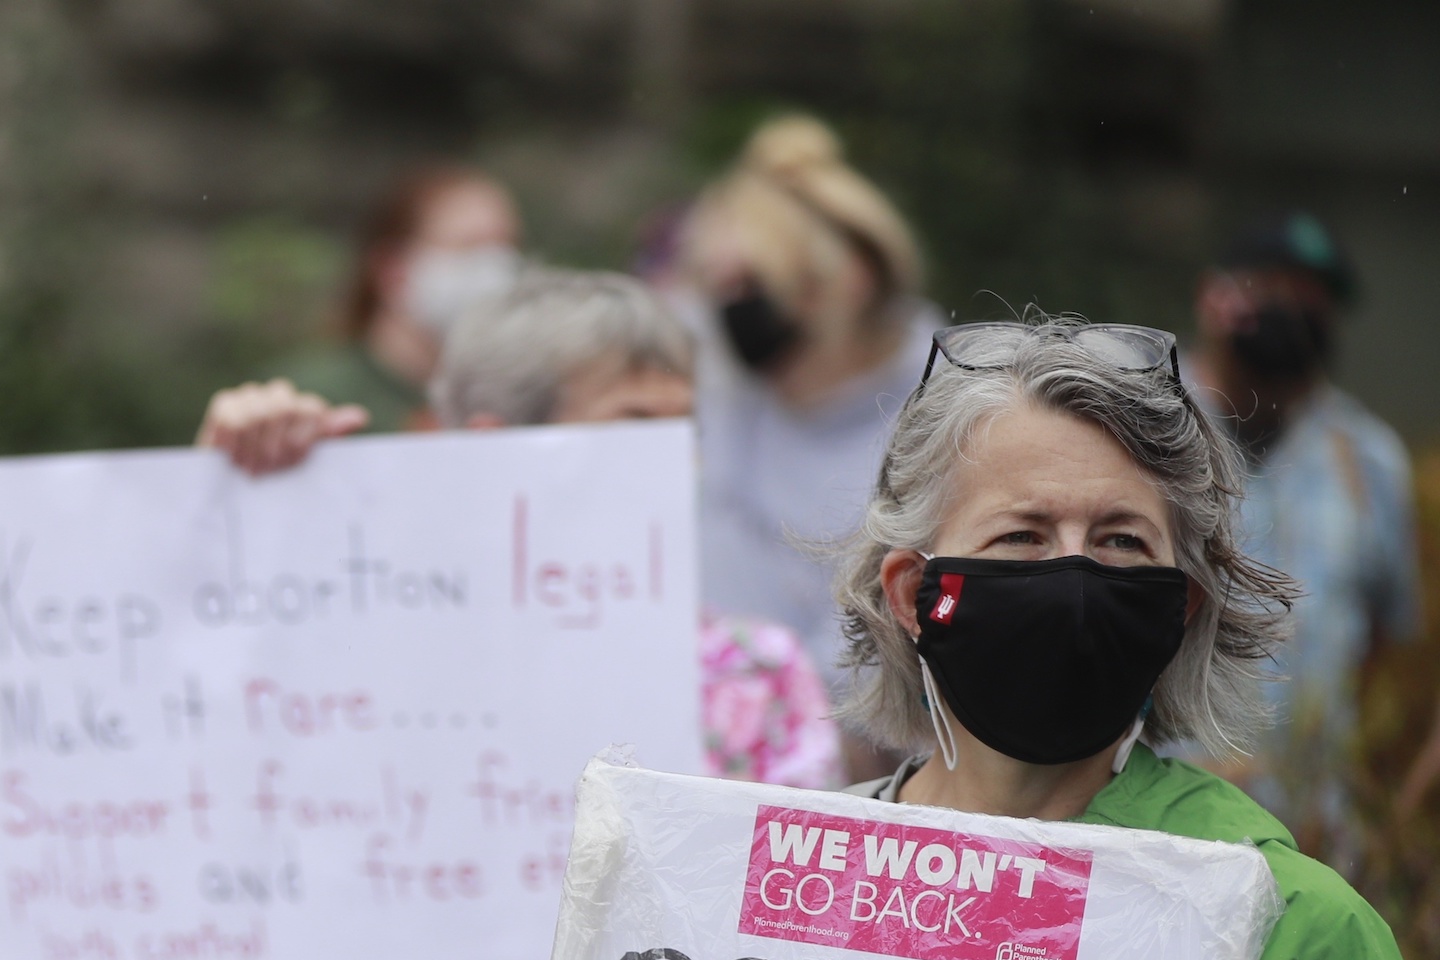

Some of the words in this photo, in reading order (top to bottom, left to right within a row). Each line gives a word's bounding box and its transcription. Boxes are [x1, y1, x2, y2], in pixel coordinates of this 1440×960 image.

[511, 492, 662, 628] legal
[362, 832, 486, 904] free
[768, 821, 849, 871] WE
[863, 835, 1046, 898] WON'T
[754, 916, 849, 940] PlannedParenthood.org
[760, 869, 834, 916] GO
[850, 881, 981, 939] BACK.
[1014, 943, 1047, 955] Planned
